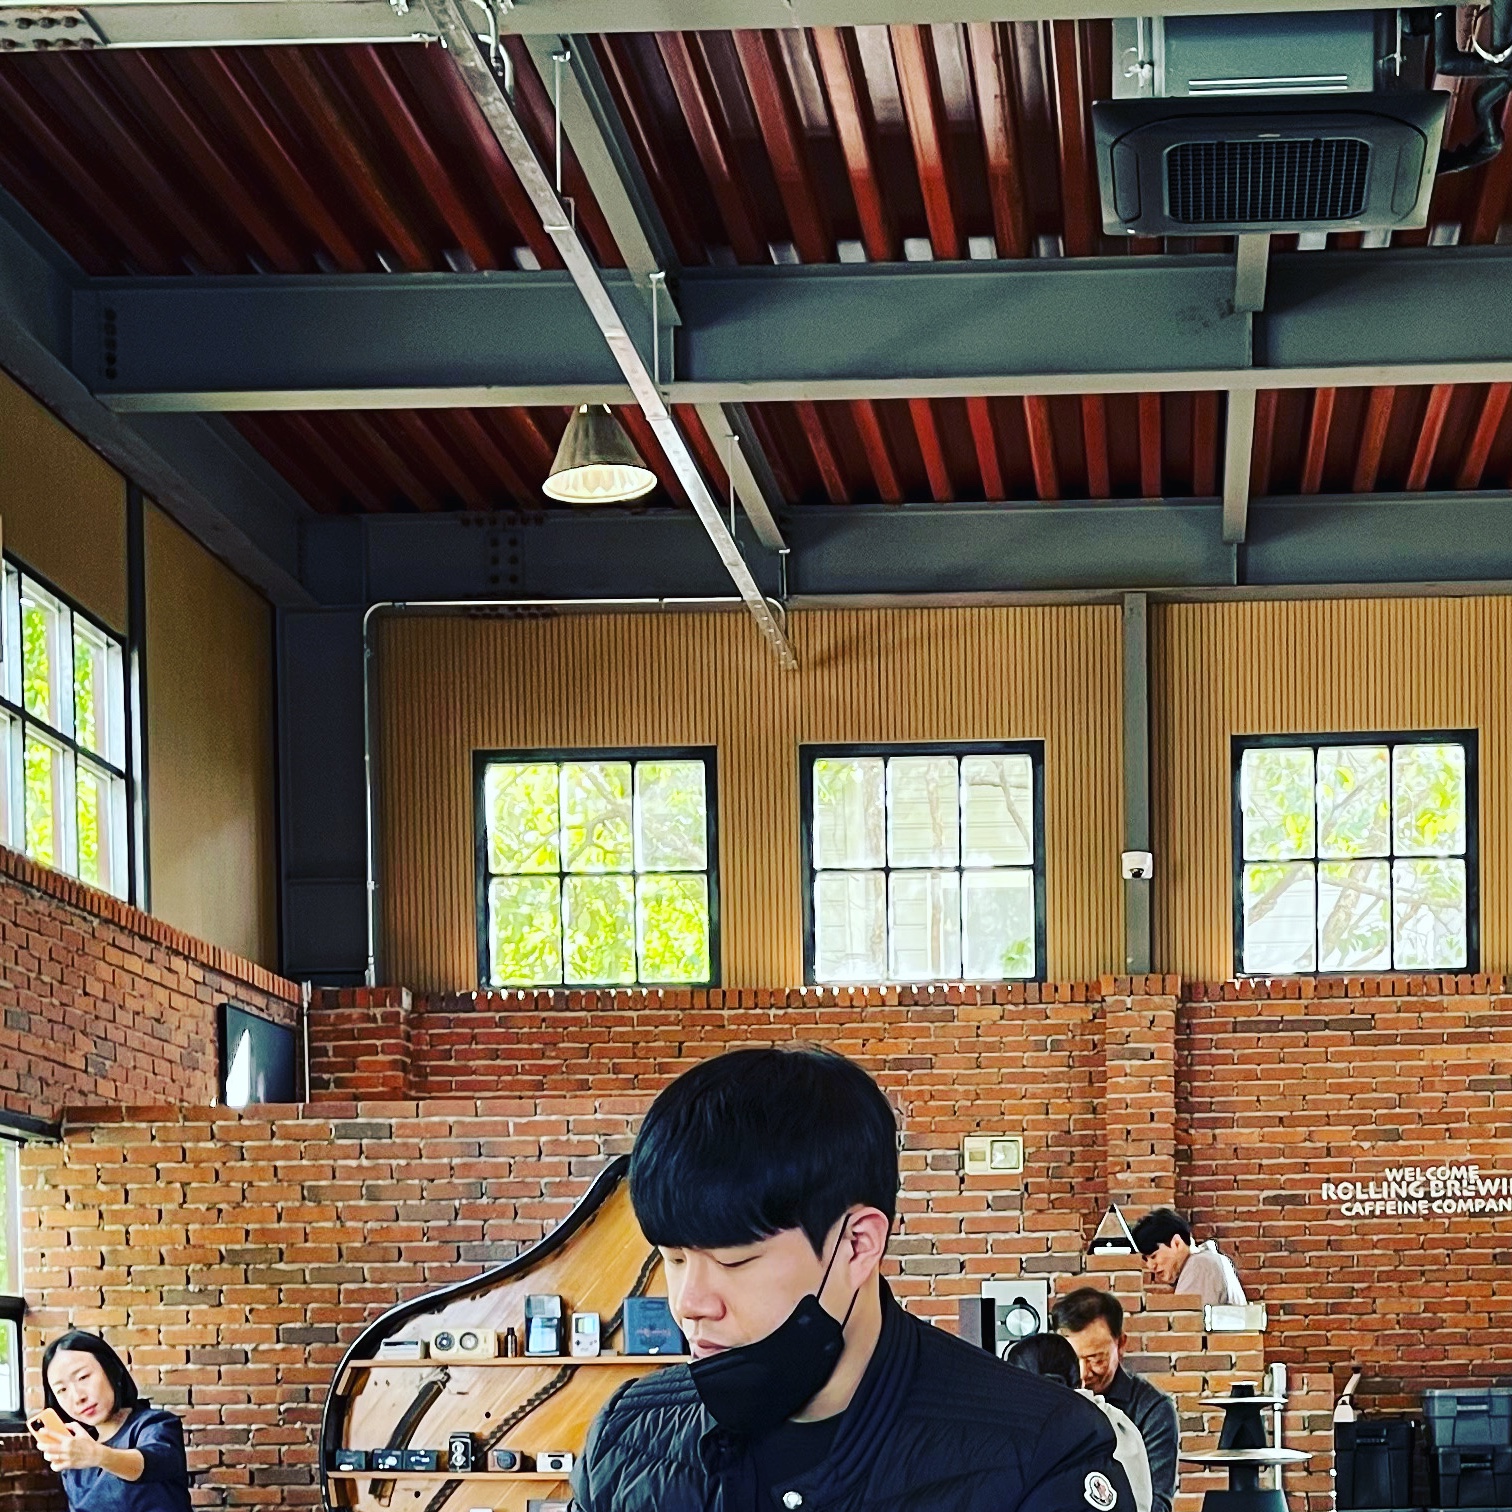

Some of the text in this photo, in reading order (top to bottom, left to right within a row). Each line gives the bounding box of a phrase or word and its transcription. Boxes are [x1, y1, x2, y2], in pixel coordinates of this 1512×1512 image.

[1385, 1164, 1480, 1183] WELCOME
[1321, 1180, 1425, 1201] ROLLING
[1340, 1199, 1429, 1217] CAFFEINE
